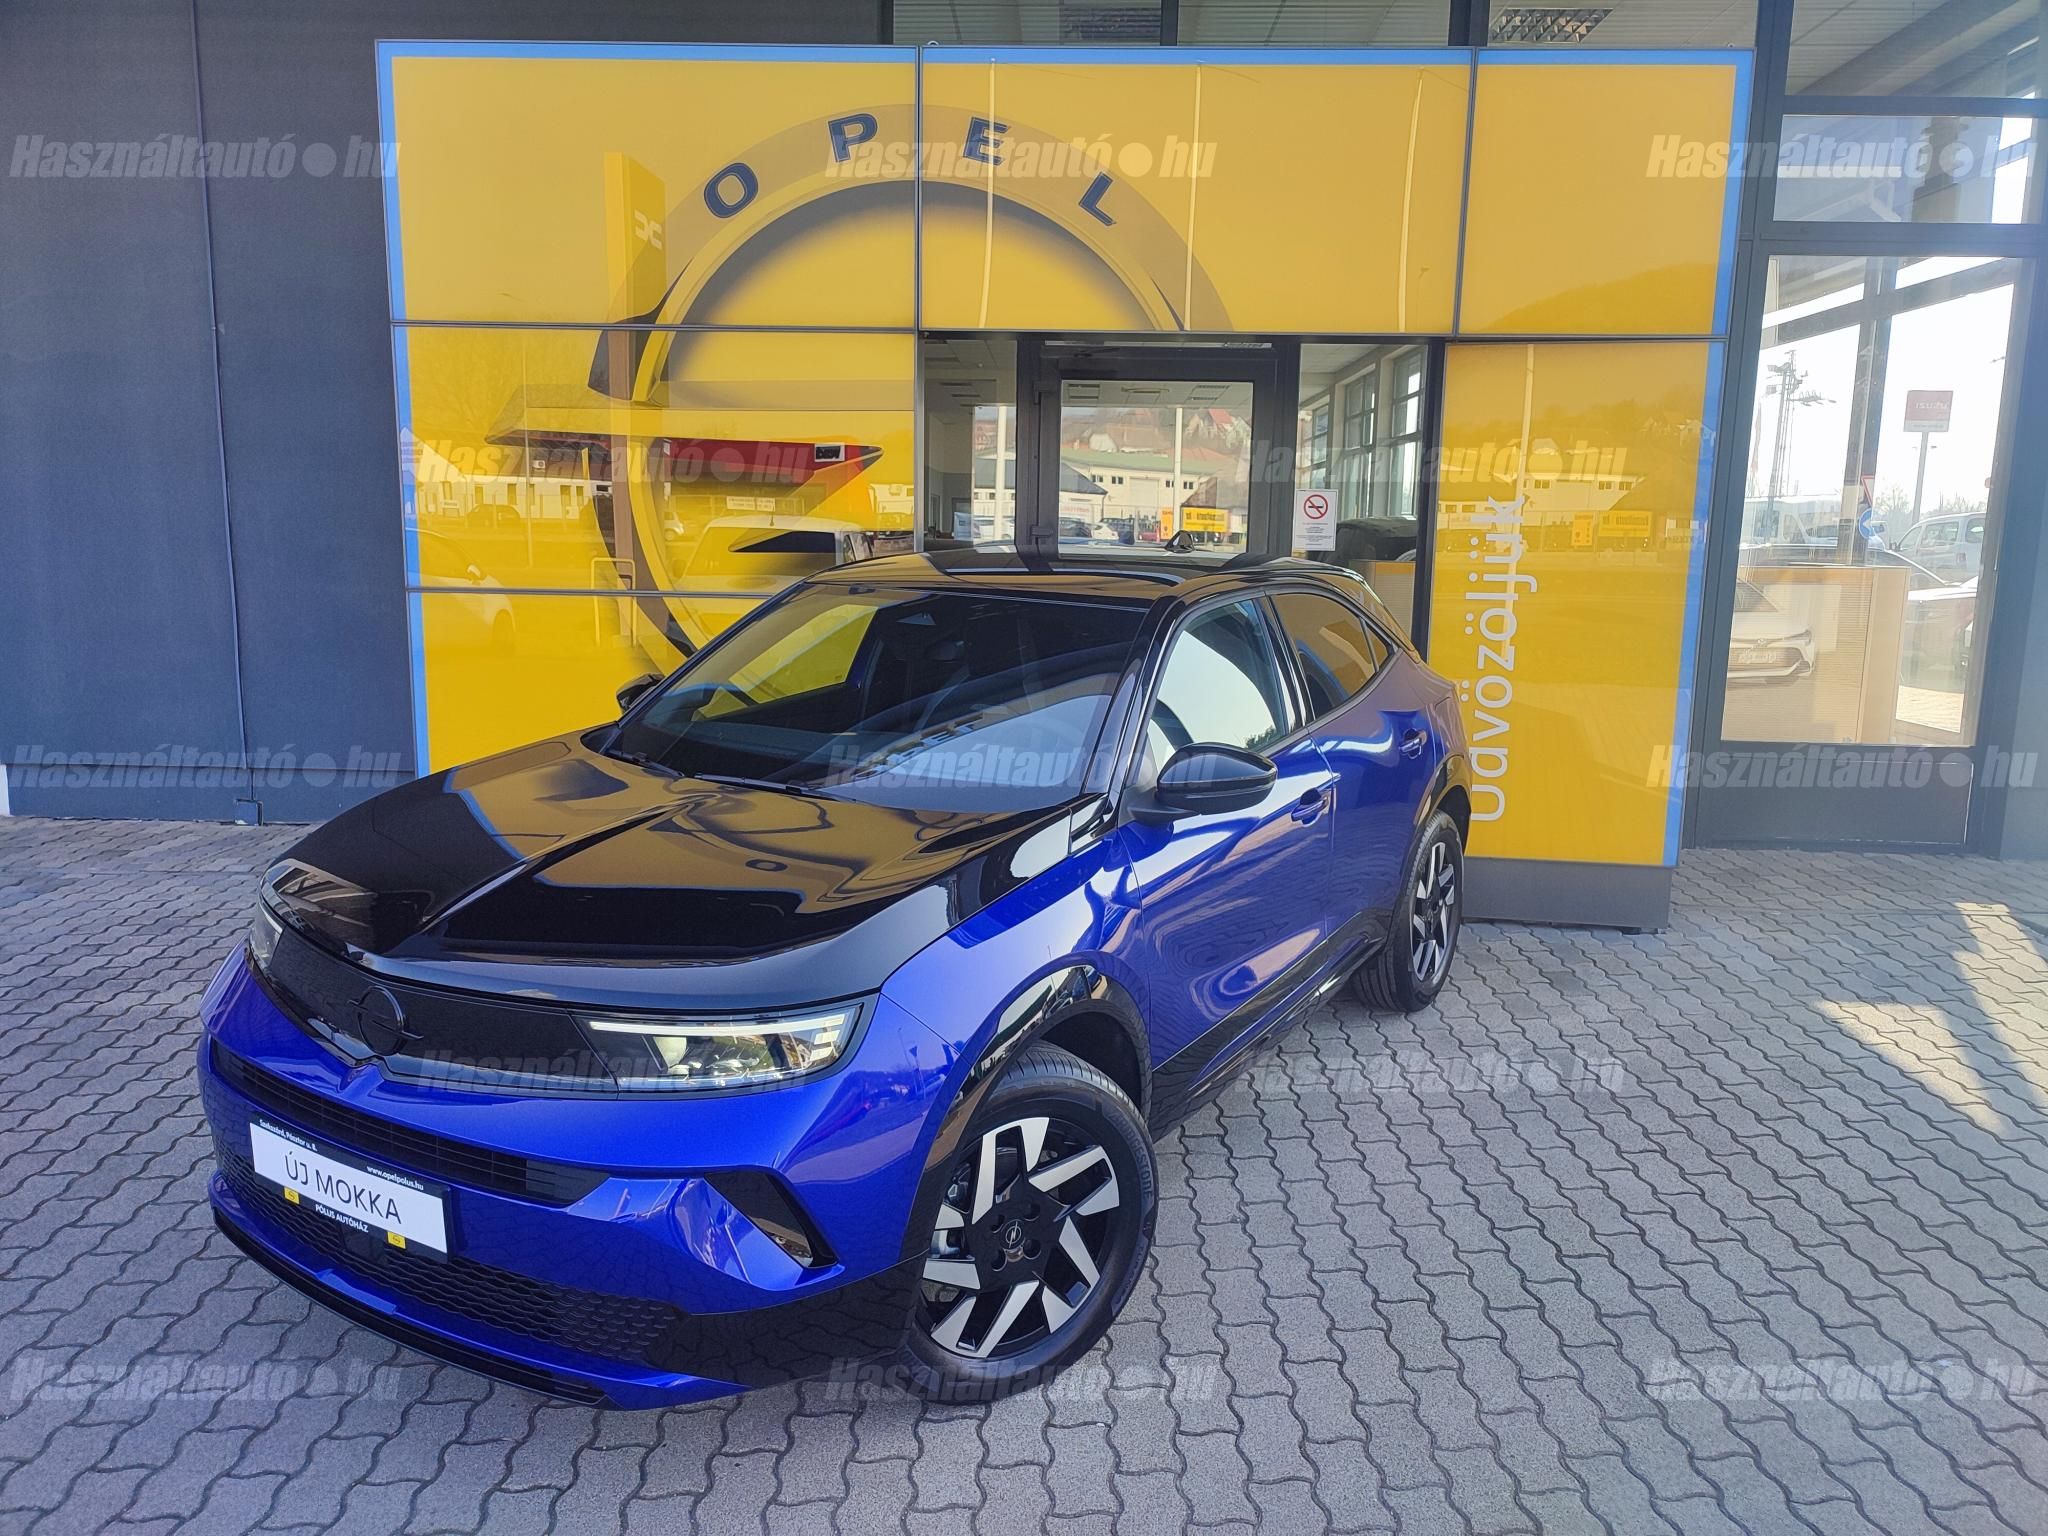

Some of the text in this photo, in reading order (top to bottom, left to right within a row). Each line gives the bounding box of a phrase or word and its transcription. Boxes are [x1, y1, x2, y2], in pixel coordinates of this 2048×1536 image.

[703, 112, 1118, 227] OPEL
[285, 1151, 402, 1225] ÚJ MOKKA
[367, 1165, 424, 1191] www.opelpolus.hu
[315, 1203, 369, 1233] PÓLUS AUTÓHÁZ
